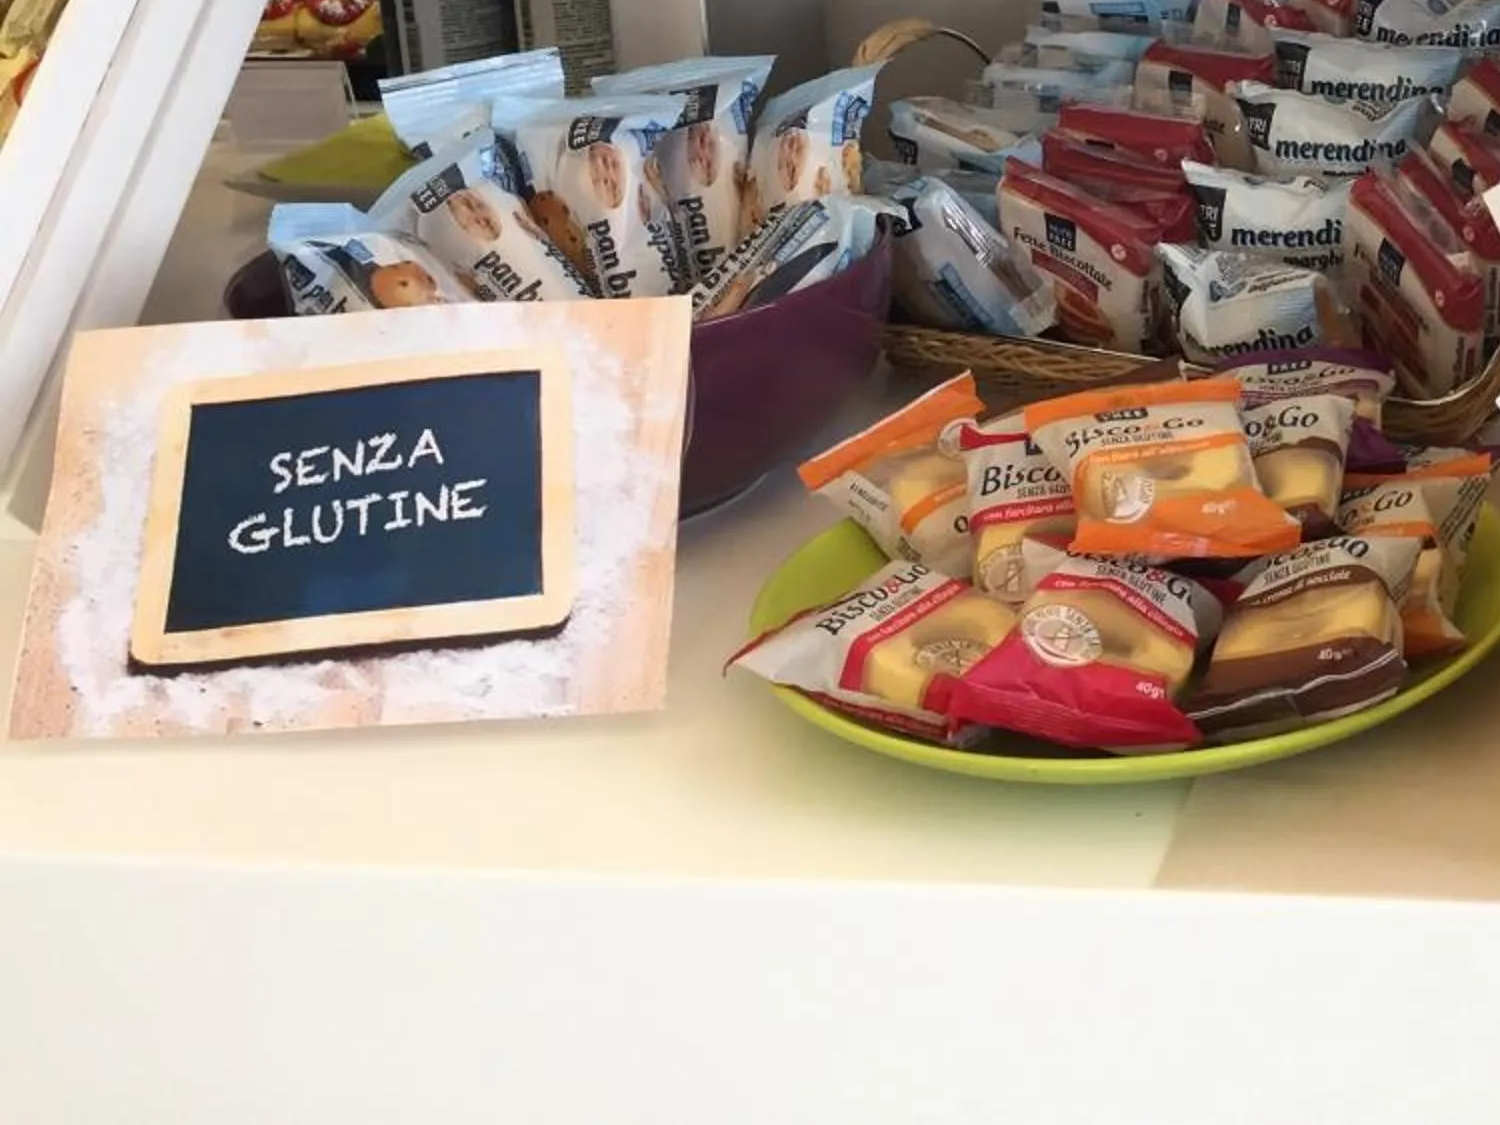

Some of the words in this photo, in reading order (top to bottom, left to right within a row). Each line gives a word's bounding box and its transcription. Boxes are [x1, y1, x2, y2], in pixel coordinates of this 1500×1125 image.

[588, 218, 621, 270] pan
[1231, 218, 1343, 248] merendi
[473, 250, 523, 298] pan
[269, 428, 445, 494] SENZA
[979, 463, 1067, 497] Bisco
[227, 479, 488, 554] GLUTINE
